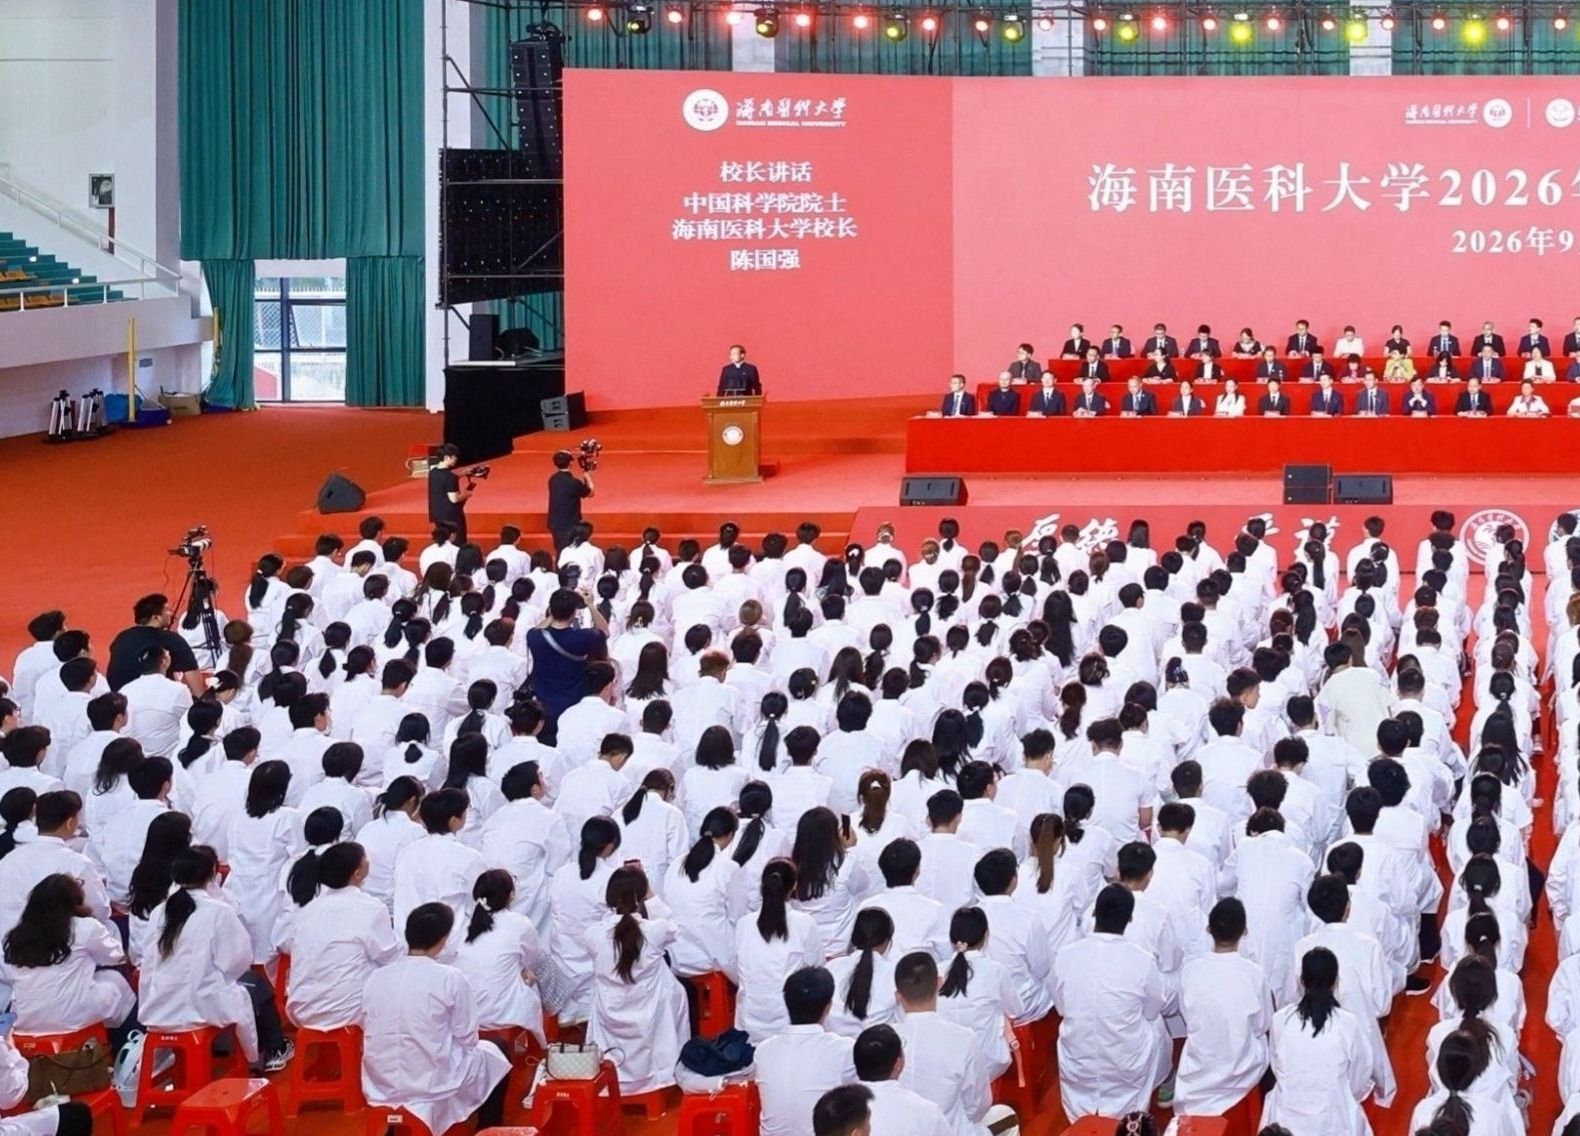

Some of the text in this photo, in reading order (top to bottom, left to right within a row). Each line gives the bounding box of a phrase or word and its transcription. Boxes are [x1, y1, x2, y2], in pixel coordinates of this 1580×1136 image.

[720, 161, 813, 183] 校长讲话
[683, 191, 846, 214] 中国科学院院士
[671, 217, 858, 240] 海南医科大学校长
[730, 248, 801, 271] 陈国强
